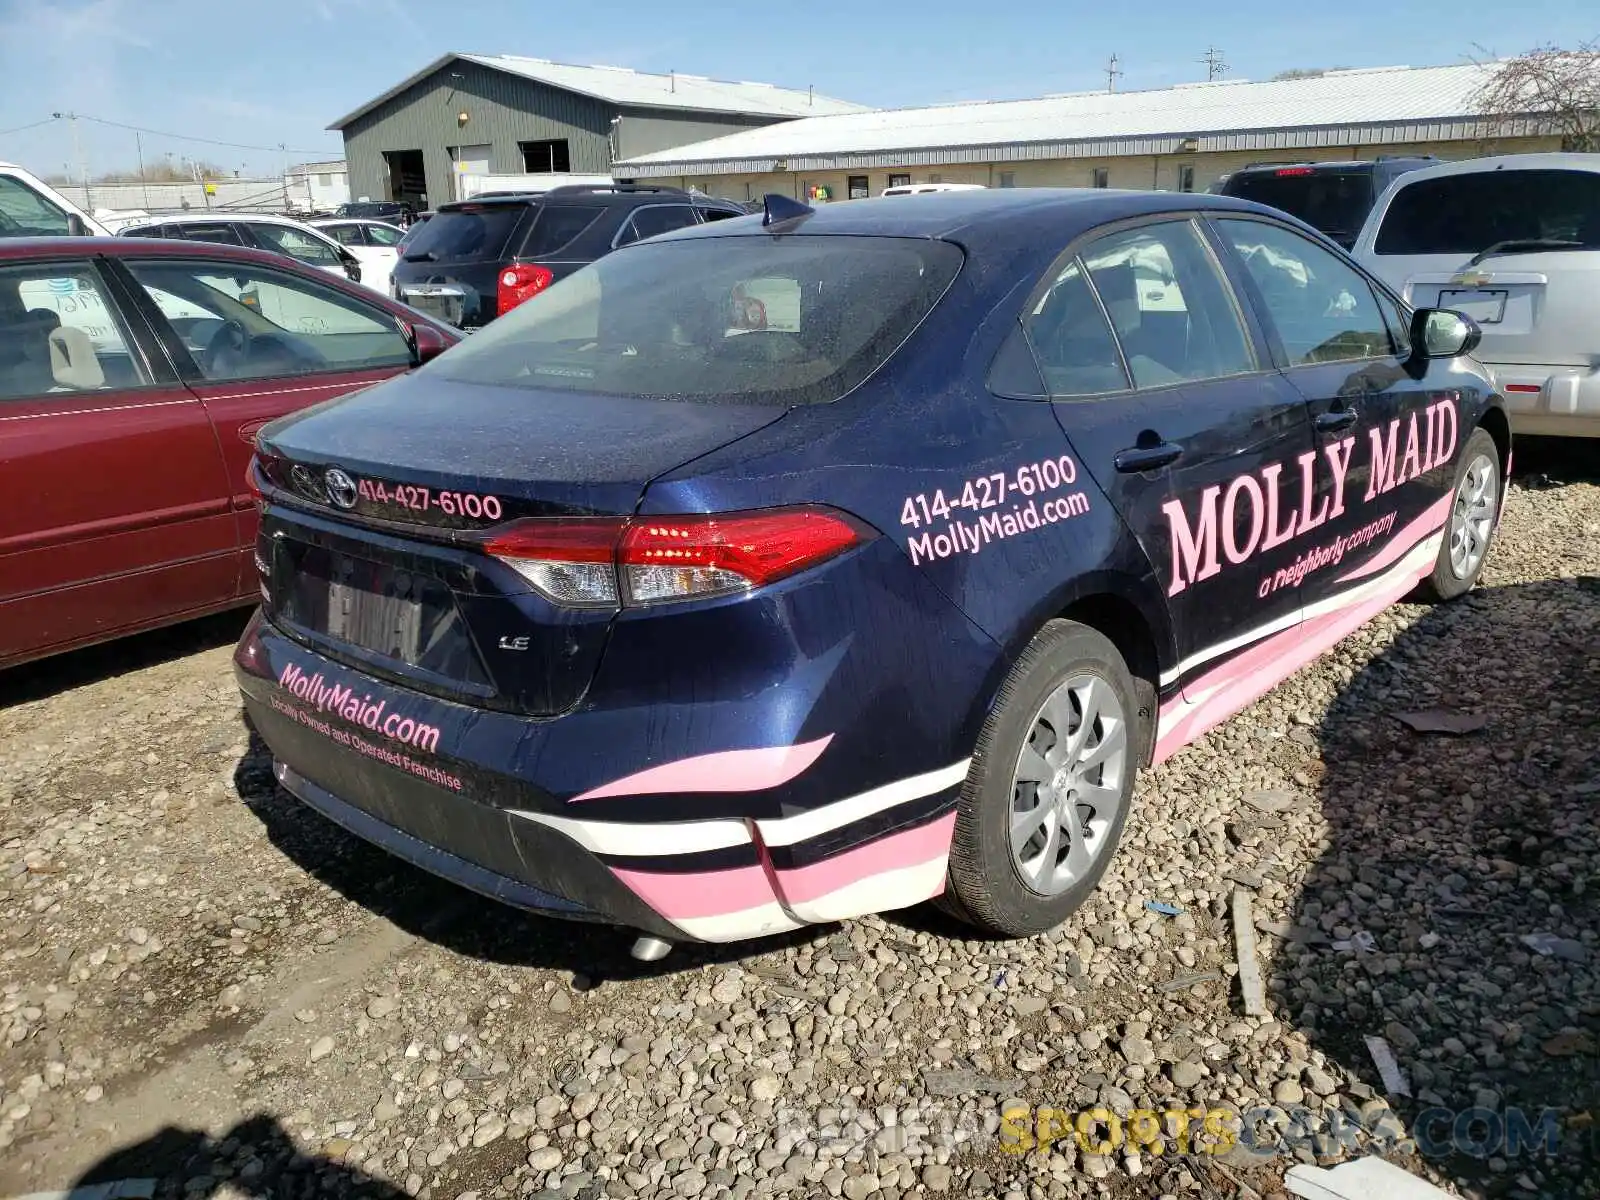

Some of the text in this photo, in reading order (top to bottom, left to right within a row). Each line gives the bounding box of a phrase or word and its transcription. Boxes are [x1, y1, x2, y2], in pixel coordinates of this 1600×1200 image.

[358, 479, 502, 520] 414-427-6100
[900, 455, 1076, 528] 414-427-6100
[907, 491, 1090, 566] MollyMaid.com
[1162, 399, 1459, 598] MOLLY MAID
[1259, 510, 1398, 598] a neighborly company
[499, 636, 530, 651] LE
[270, 694, 463, 791] Locally Owned and Operated Franchise
[279, 662, 440, 754] MollyMaid.com
